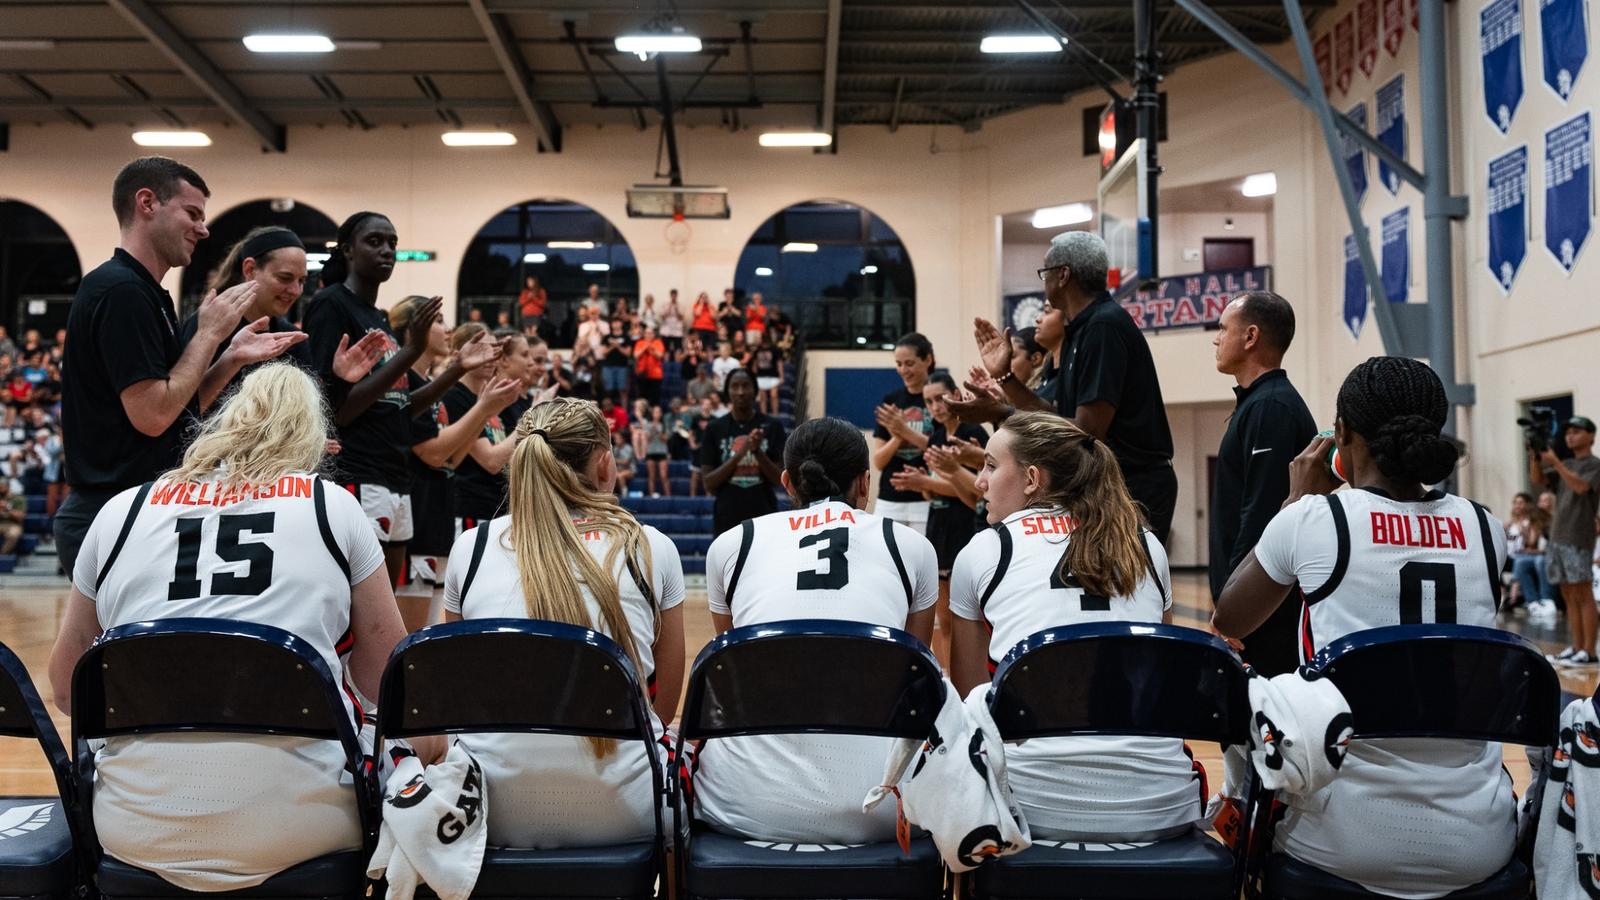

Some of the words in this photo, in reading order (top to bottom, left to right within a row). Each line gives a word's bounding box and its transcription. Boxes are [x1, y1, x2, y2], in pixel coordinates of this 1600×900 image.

[1185, 271, 1259, 296] HALL
[1121, 292, 1230, 329] RTAN
[788, 507, 856, 531] VILLA
[1370, 511, 1467, 550] BOLDEN
[168, 511, 276, 601] 15
[796, 526, 849, 590] 3
[1399, 561, 1457, 625] 0
[437, 756, 483, 845] GAT
